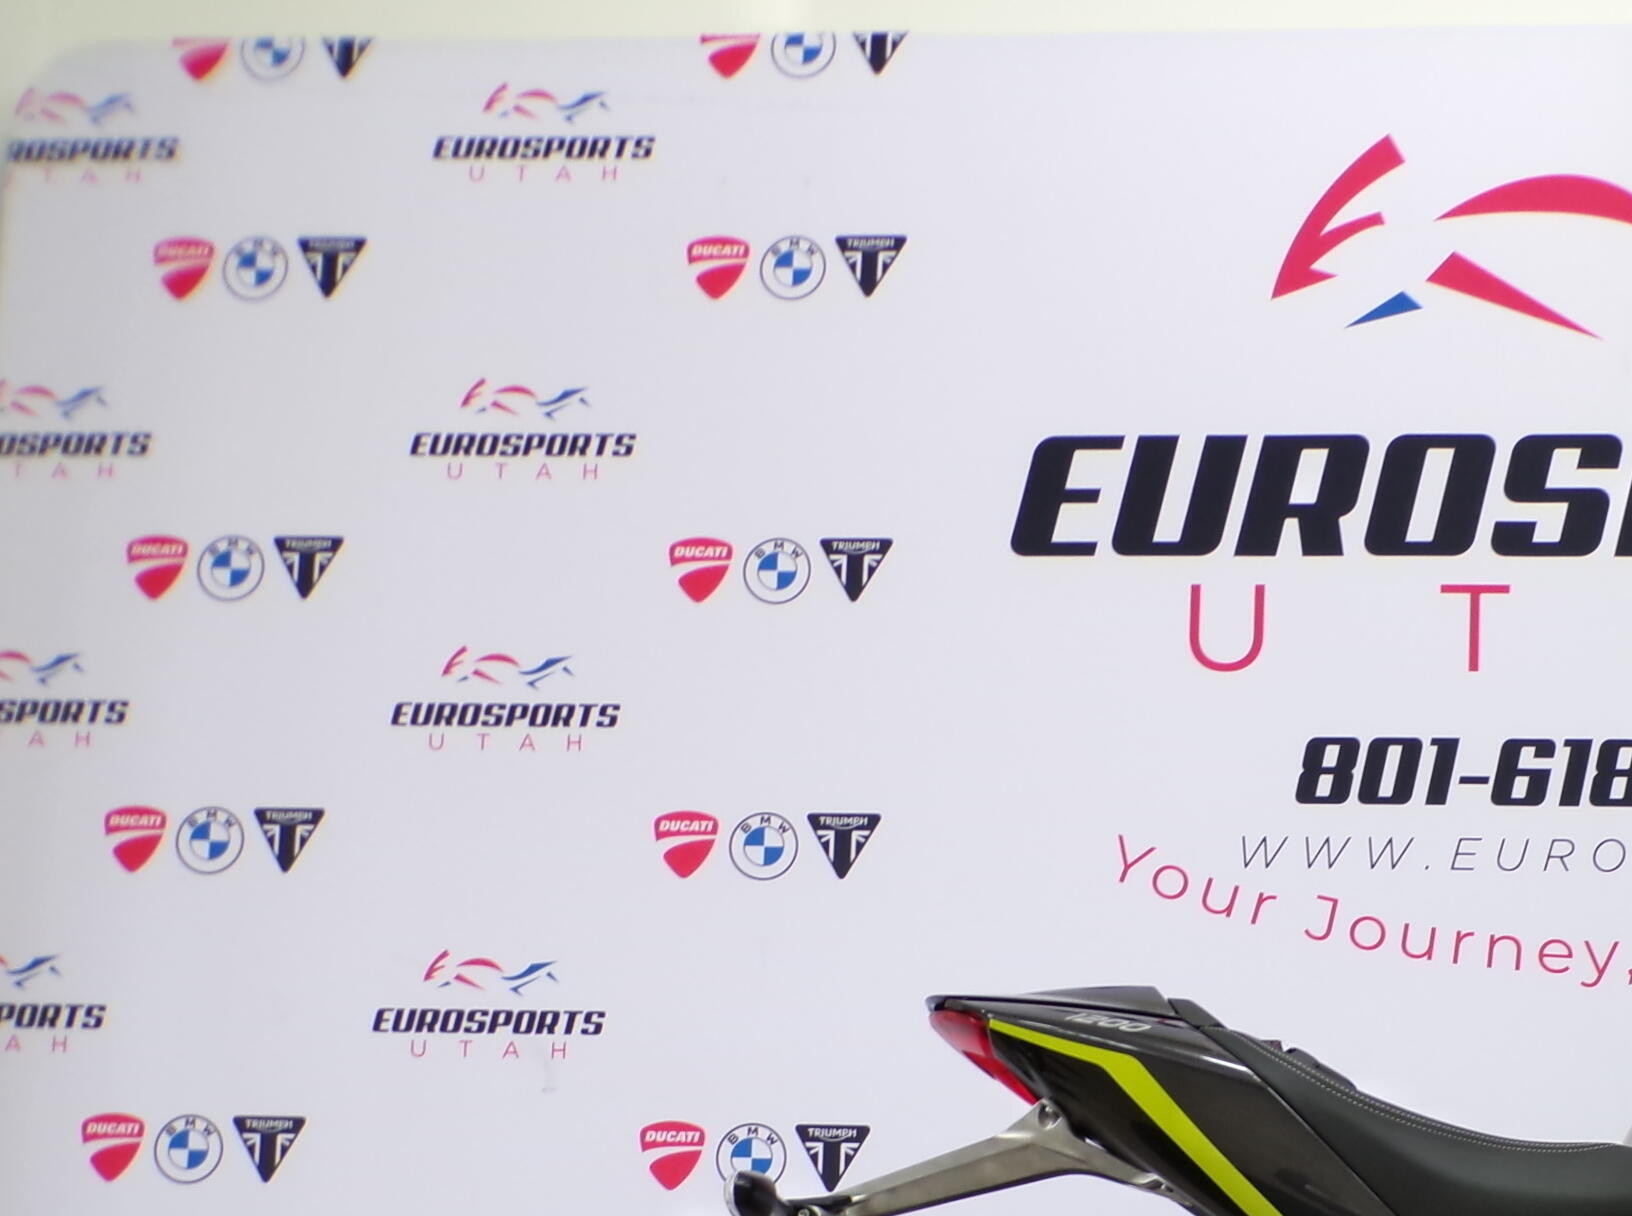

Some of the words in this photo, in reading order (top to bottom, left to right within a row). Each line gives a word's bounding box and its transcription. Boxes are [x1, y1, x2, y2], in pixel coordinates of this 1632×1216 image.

[434, 138, 654, 158] EUROSPORTS
[467, 165, 621, 184] UTAH
[691, 245, 746, 256] DUCATI
[770, 239, 817, 256] BMW
[847, 238, 895, 248] TRIUMPH
[410, 434, 636, 456] EUROSPORTS
[447, 462, 602, 480] UTAH
[131, 544, 184, 555] DUCATI
[208, 538, 256, 556] BMW
[286, 540, 332, 548] TRIUMPH
[675, 546, 728, 558] DUCATI
[755, 541, 803, 558] BMW
[832, 541, 881, 551] TRIUMPH
[391, 703, 620, 727] EUROSPORTS
[427, 732, 585, 751] UTAH
[110, 814, 163, 826] DUCATI
[188, 809, 236, 827] BMW
[266, 811, 313, 820] TRIUMPH
[819, 816, 868, 826] TRIUMPH
[660, 820, 714, 832] DUCATI
[740, 816, 790, 834] BMW
[1117, 834, 1278, 925] Your
[373, 1009, 605, 1035] EUROSPORTS
[1064, 1013, 1152, 1032] 1200
[411, 1040, 568, 1059] UTAH
[87, 1121, 139, 1134] DUCATI
[165, 1117, 213, 1135] BMW
[245, 1119, 293, 1129] TRIUMPH
[808, 1127, 857, 1137] TRIUMPH
[645, 1131, 699, 1142] DUCATI
[728, 1127, 778, 1145] BMW
